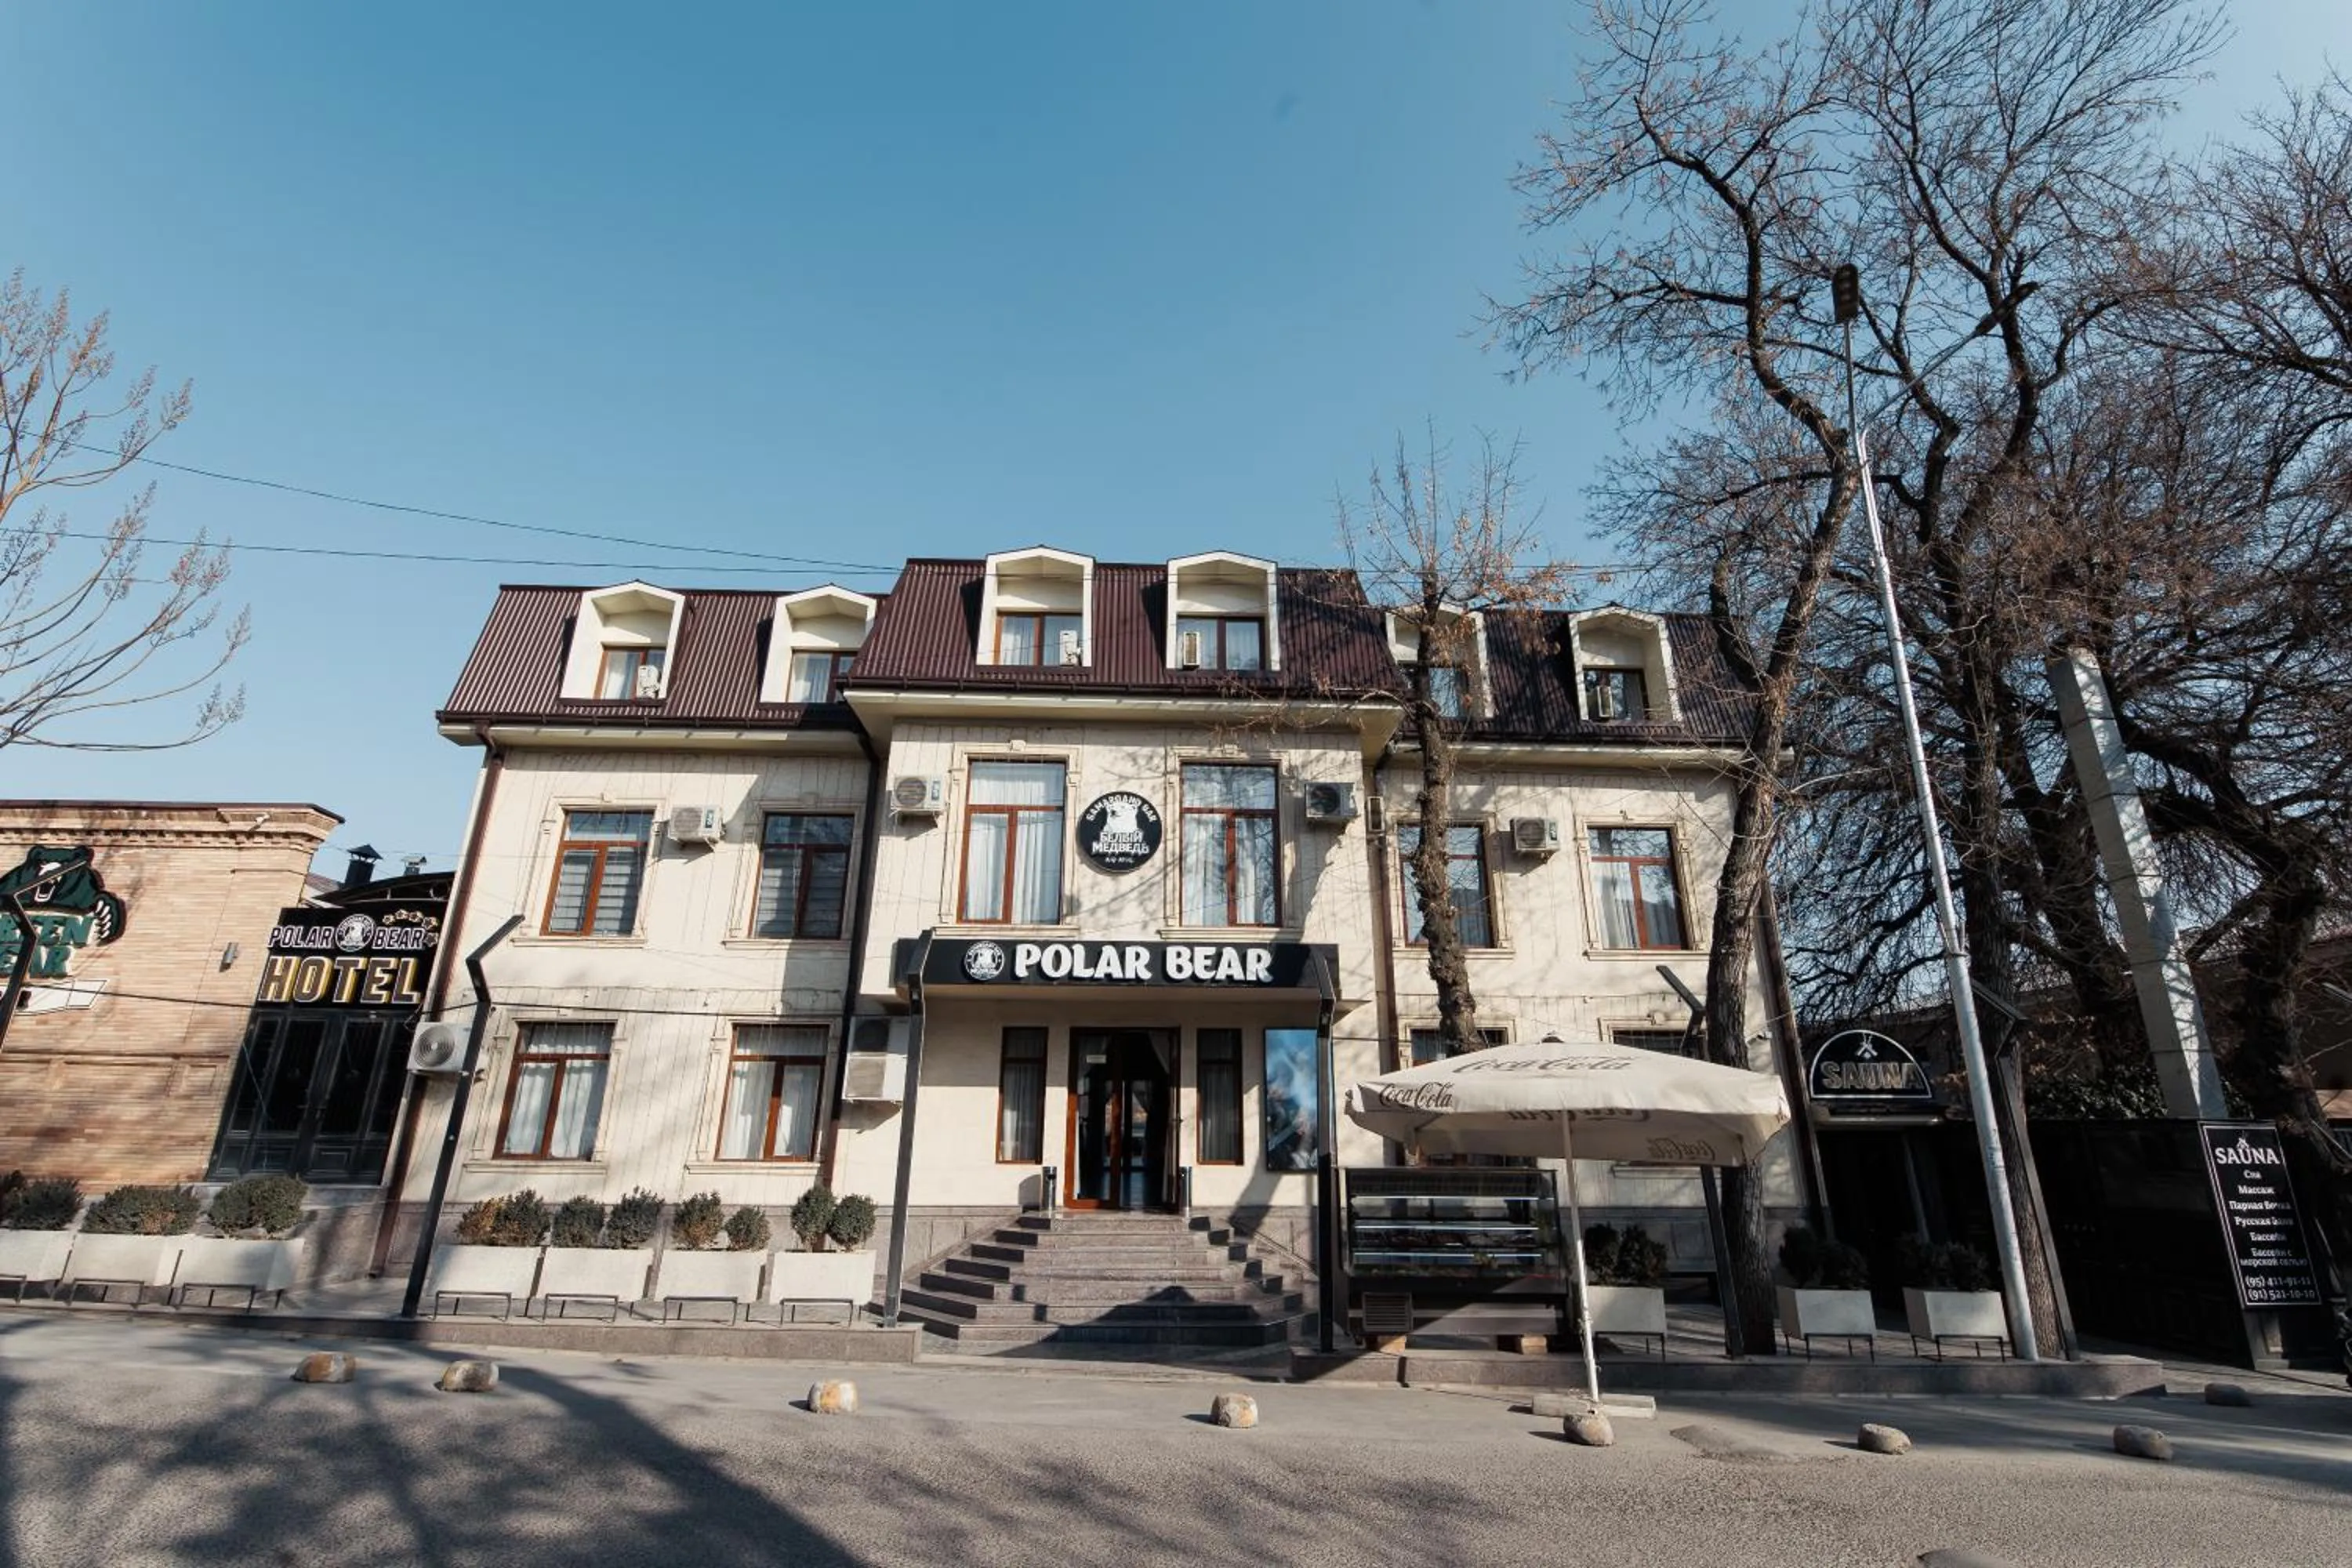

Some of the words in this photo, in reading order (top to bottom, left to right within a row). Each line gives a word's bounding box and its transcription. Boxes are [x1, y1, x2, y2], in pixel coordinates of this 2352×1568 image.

[1100, 829, 1144, 843] БЕЛЫЙ
[1091, 840, 1150, 856] МЕДВЕДЬ
[267, 925, 335, 949] POLAR
[372, 927, 425, 949] BEAR
[1014, 942, 1152, 979] POLAR
[1166, 946, 1273, 982] BEAR
[257, 956, 422, 1004] HOTEL
[1820, 1061, 1925, 1090] SAUNA
[2215, 1147, 2281, 1164] SAUNA
[2238, 1185, 2275, 1194] Массаж
[2229, 1201, 2263, 1212] Парная
[2234, 1217, 2271, 1228] Русская
[2245, 1276, 2265, 1287] (95)
